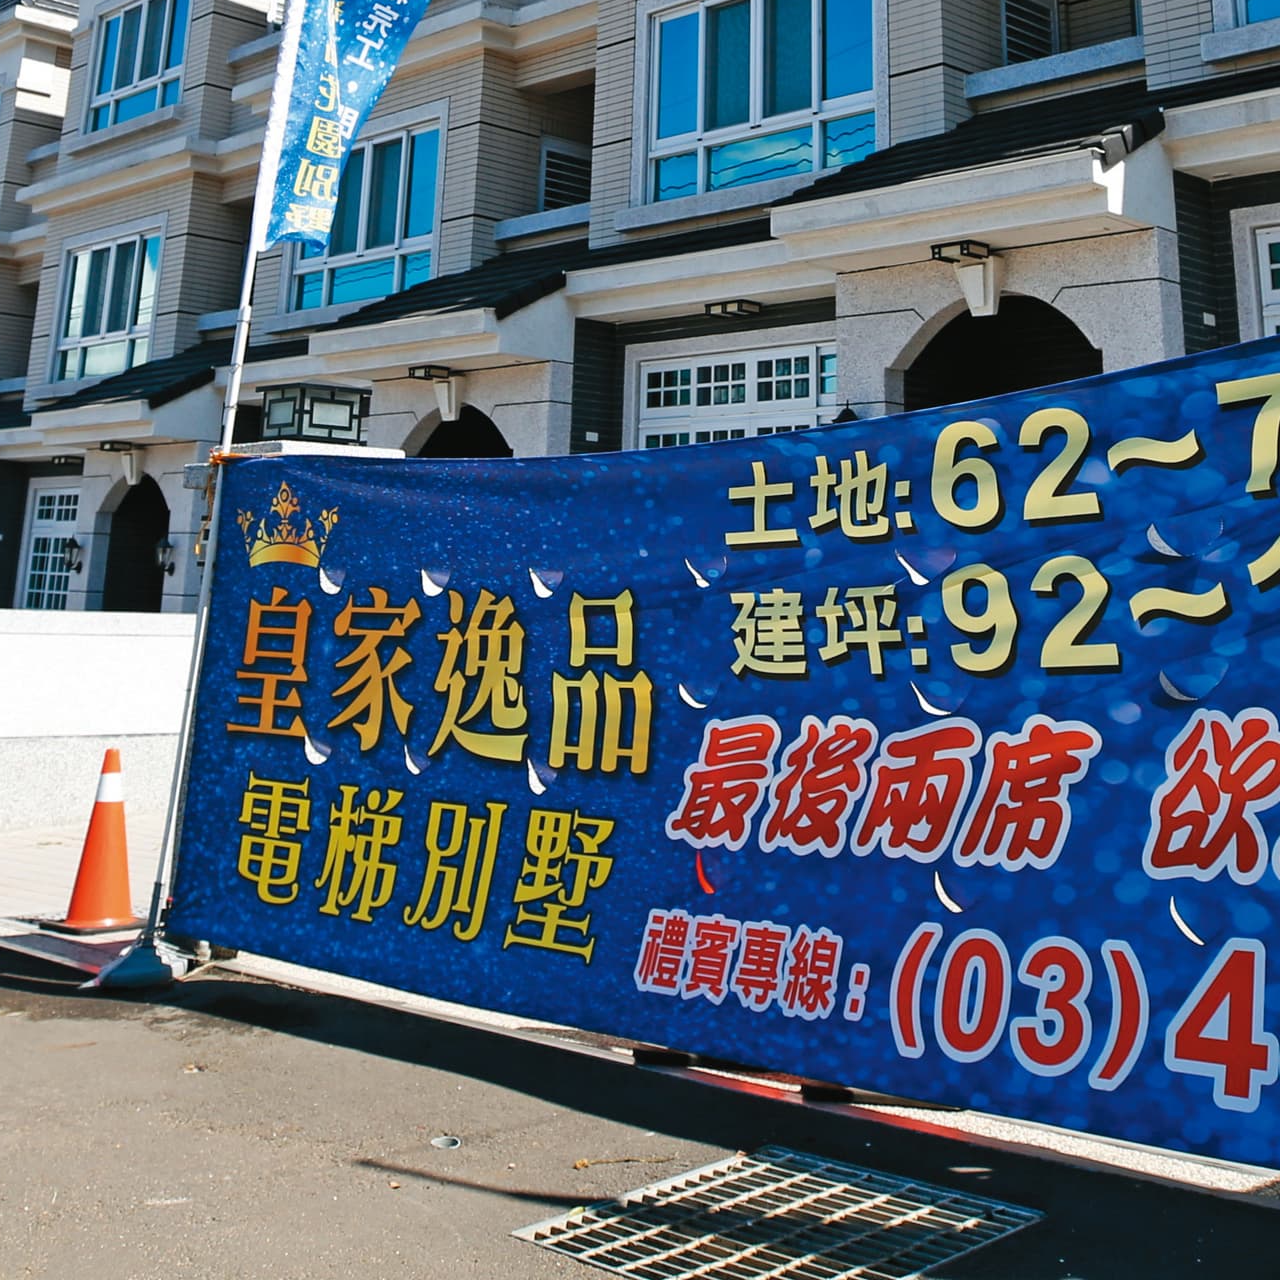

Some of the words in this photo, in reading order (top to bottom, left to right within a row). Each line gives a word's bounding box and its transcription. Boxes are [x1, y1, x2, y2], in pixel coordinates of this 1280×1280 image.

[226, 586, 654, 775] 皇家逸品
[237, 771, 615, 965] 電梯別墅
[666, 714, 1102, 871] 最後兩席
